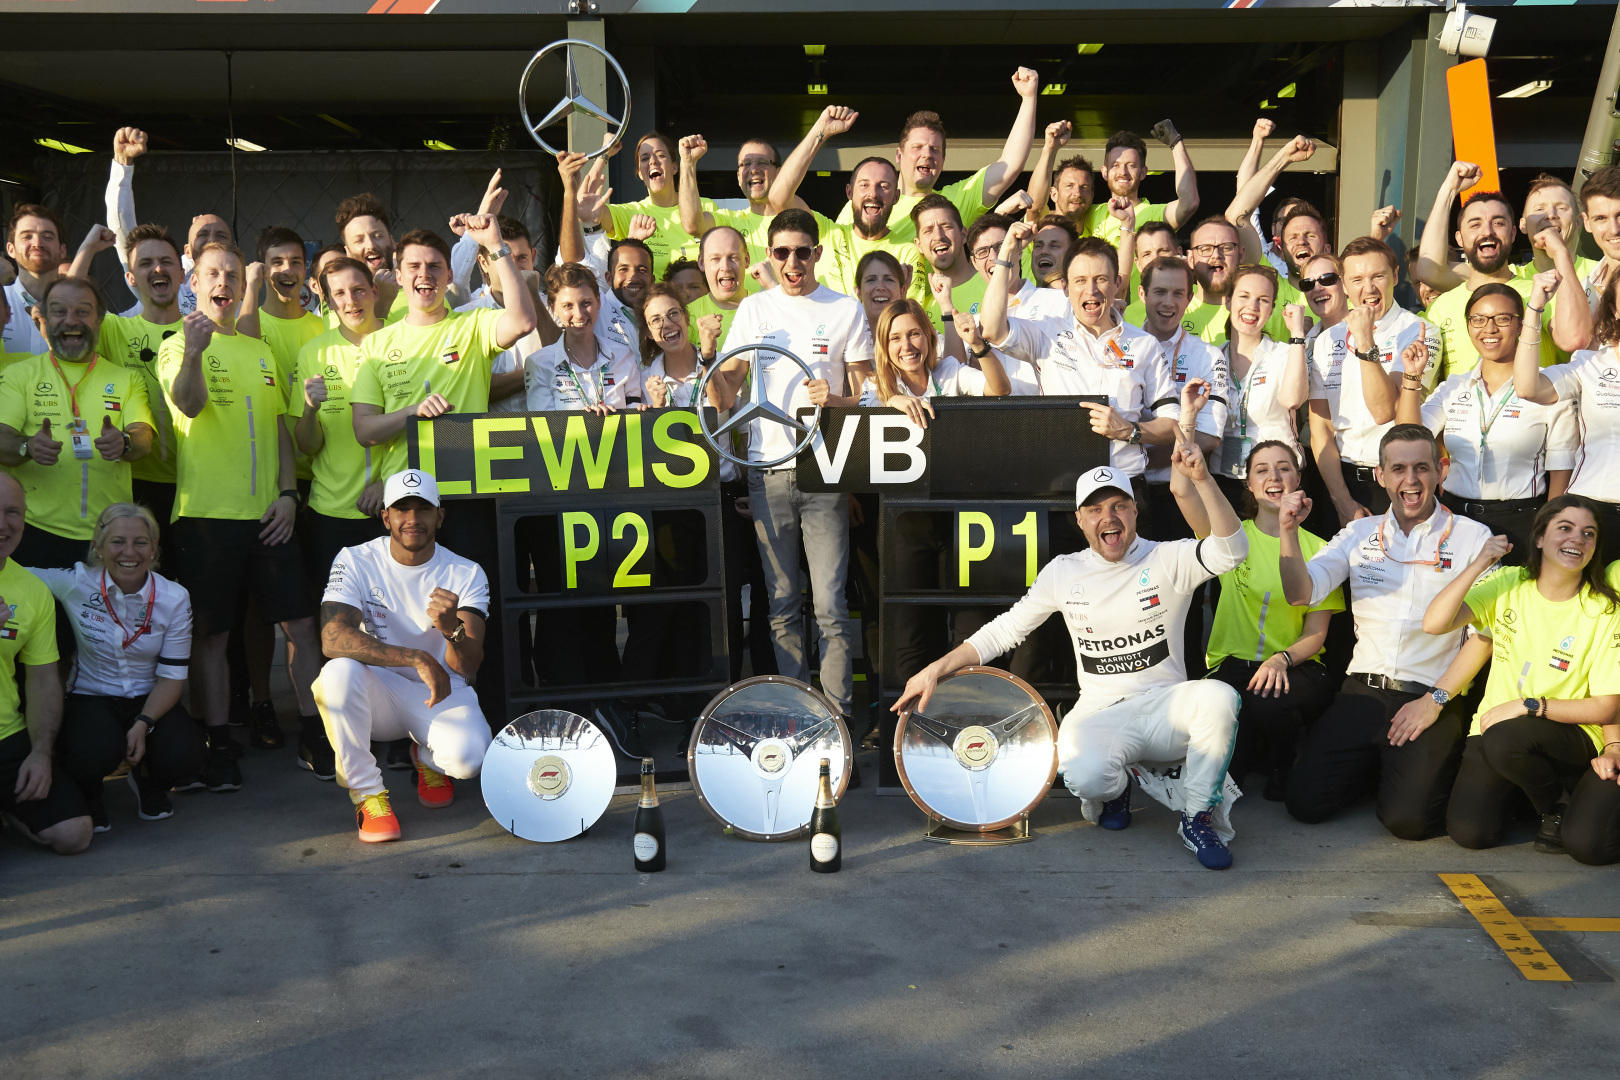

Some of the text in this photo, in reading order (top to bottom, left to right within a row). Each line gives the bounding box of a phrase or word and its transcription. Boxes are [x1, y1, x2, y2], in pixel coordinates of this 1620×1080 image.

[393, 369, 407, 377] UBS
[417, 410, 711, 495] LEWIS
[801, 414, 928, 485] VB
[561, 510, 652, 589] P2
[958, 511, 1038, 588] P1
[1358, 562, 1386, 573] Qualcomm
[1136, 585, 1160, 596] PETRONAS
[91, 614, 105, 623] UBS
[373, 611, 387, 619] UBS
[1074, 613, 1089, 621] UBS
[1078, 624, 1166, 652] PETRONAS
[1100, 652, 1142, 664] MARRIOTT
[1096, 655, 1151, 674] BONVOY
[1503, 933, 1521, 941] 10
